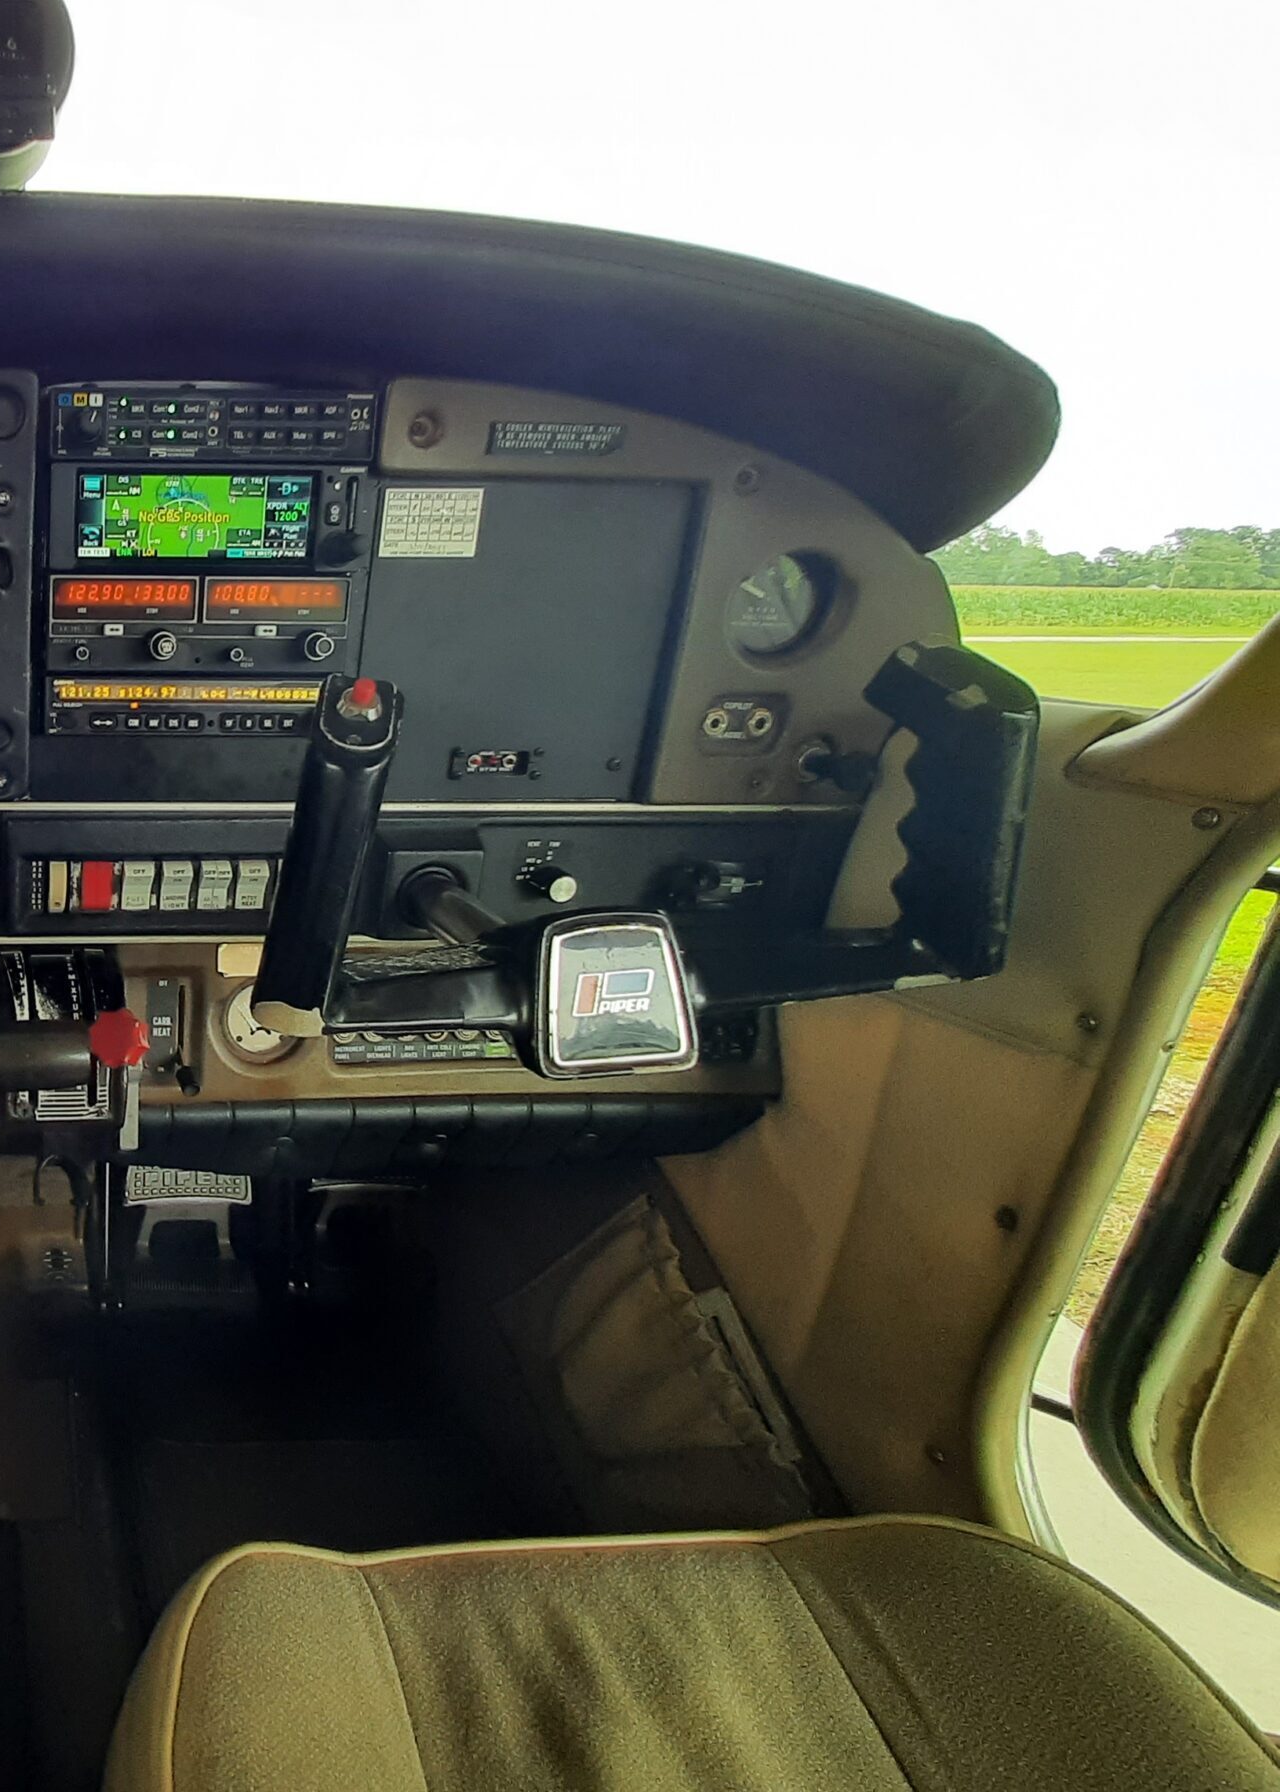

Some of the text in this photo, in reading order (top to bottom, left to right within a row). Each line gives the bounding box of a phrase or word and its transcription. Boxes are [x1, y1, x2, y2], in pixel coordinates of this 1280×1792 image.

[77, 396, 85, 404] M
[132, 430, 141, 438] ICS
[234, 431, 244, 439] TEL
[139, 512, 230, 523] No GPS Position
[275, 511, 297, 521] 1200
[68, 584, 124, 601] 122.90
[134, 584, 189, 602] 133.00
[214, 584, 270, 602] 108.80
[61, 687, 110, 697] 121.25
[723, 702, 754, 710] COPILOT
[599, 998, 650, 1014] PIPER
[153, 1027, 171, 1036] HEAT
